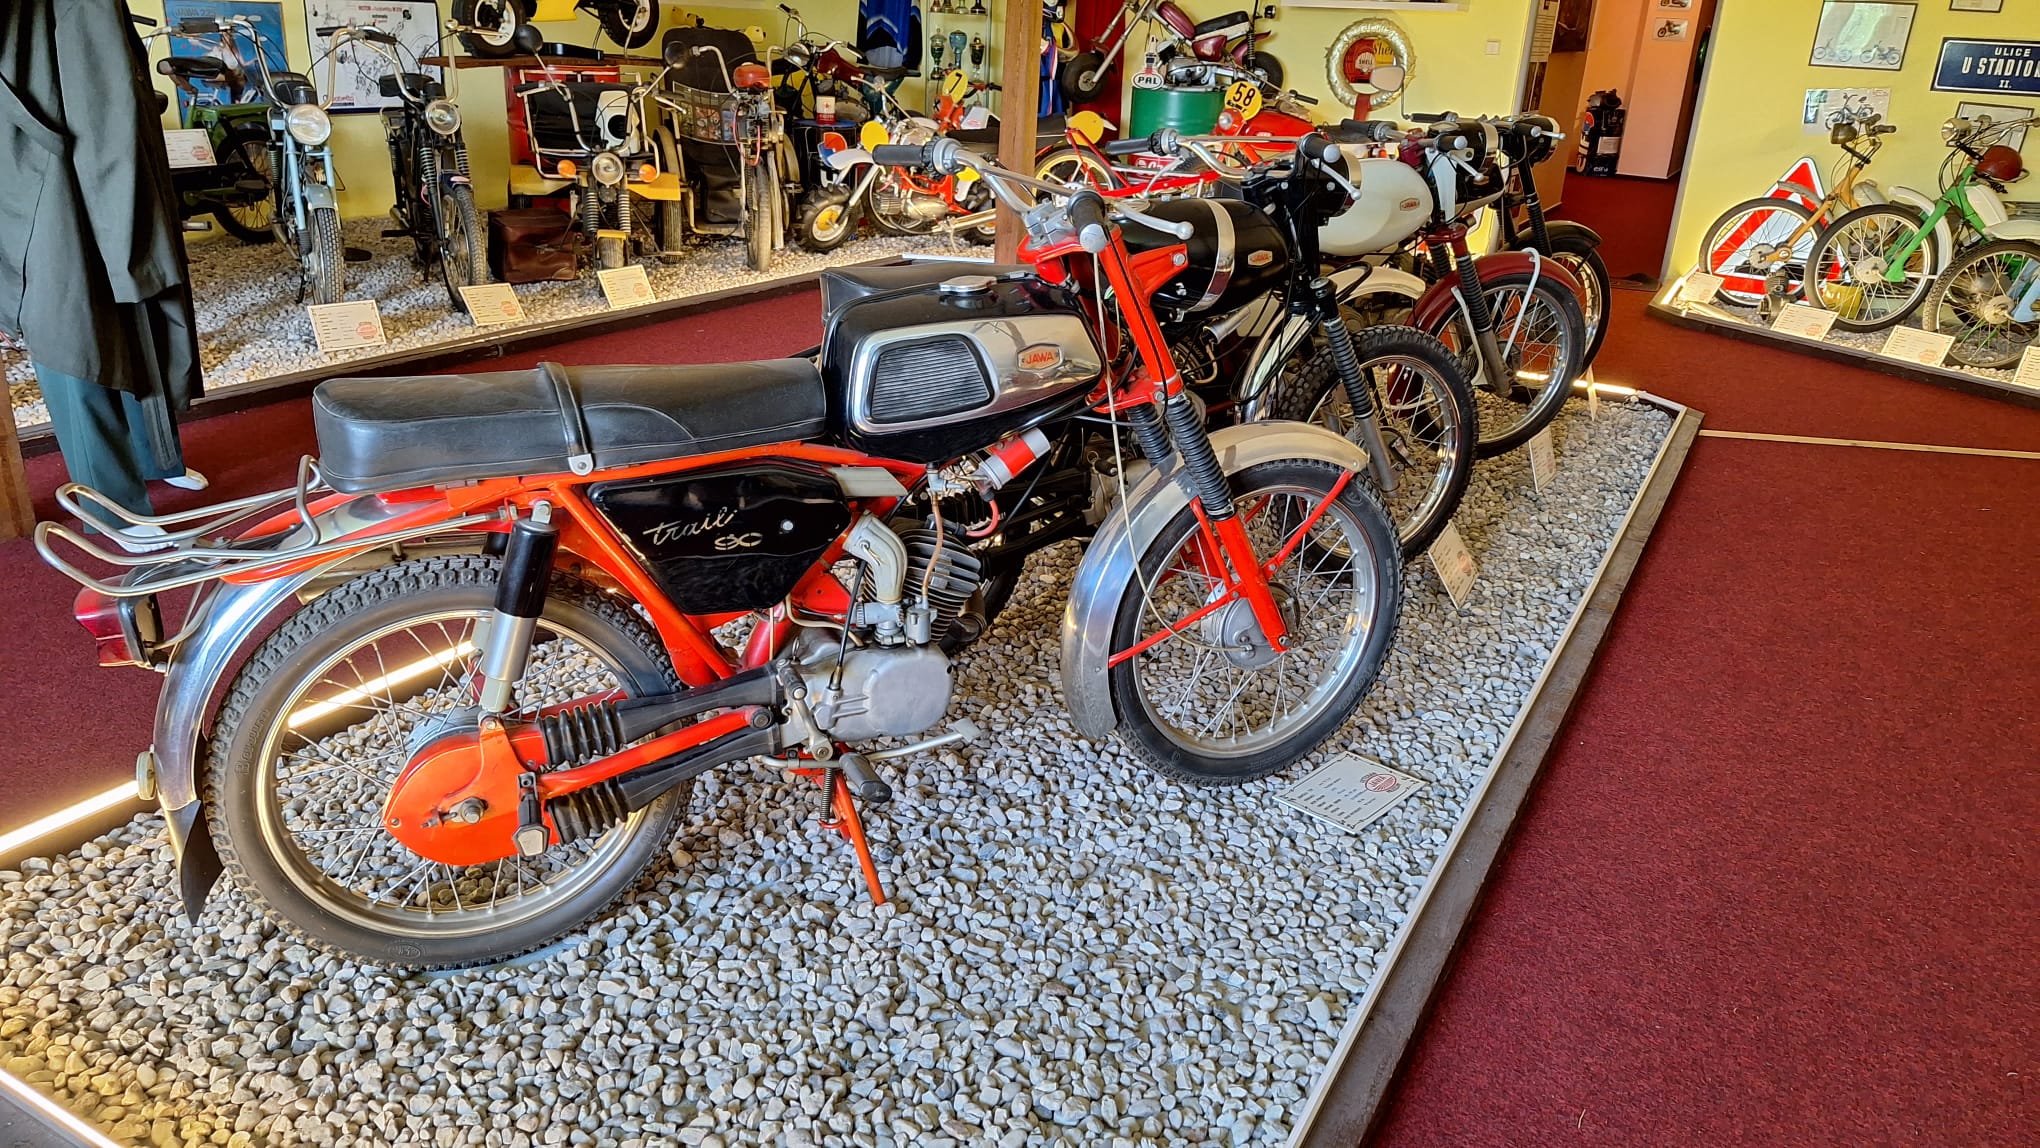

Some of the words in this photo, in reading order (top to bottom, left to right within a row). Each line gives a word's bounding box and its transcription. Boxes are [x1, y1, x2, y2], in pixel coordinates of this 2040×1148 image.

[1994, 47, 2031, 57] ULICE
[1961, 56, 1972, 74] U
[949, 72, 963, 94] 7
[1137, 76, 1159, 85] PAL
[1998, 79, 2012, 88] II.
[1232, 82, 1256, 107] 58
[1025, 351, 1055, 365] JAWA
